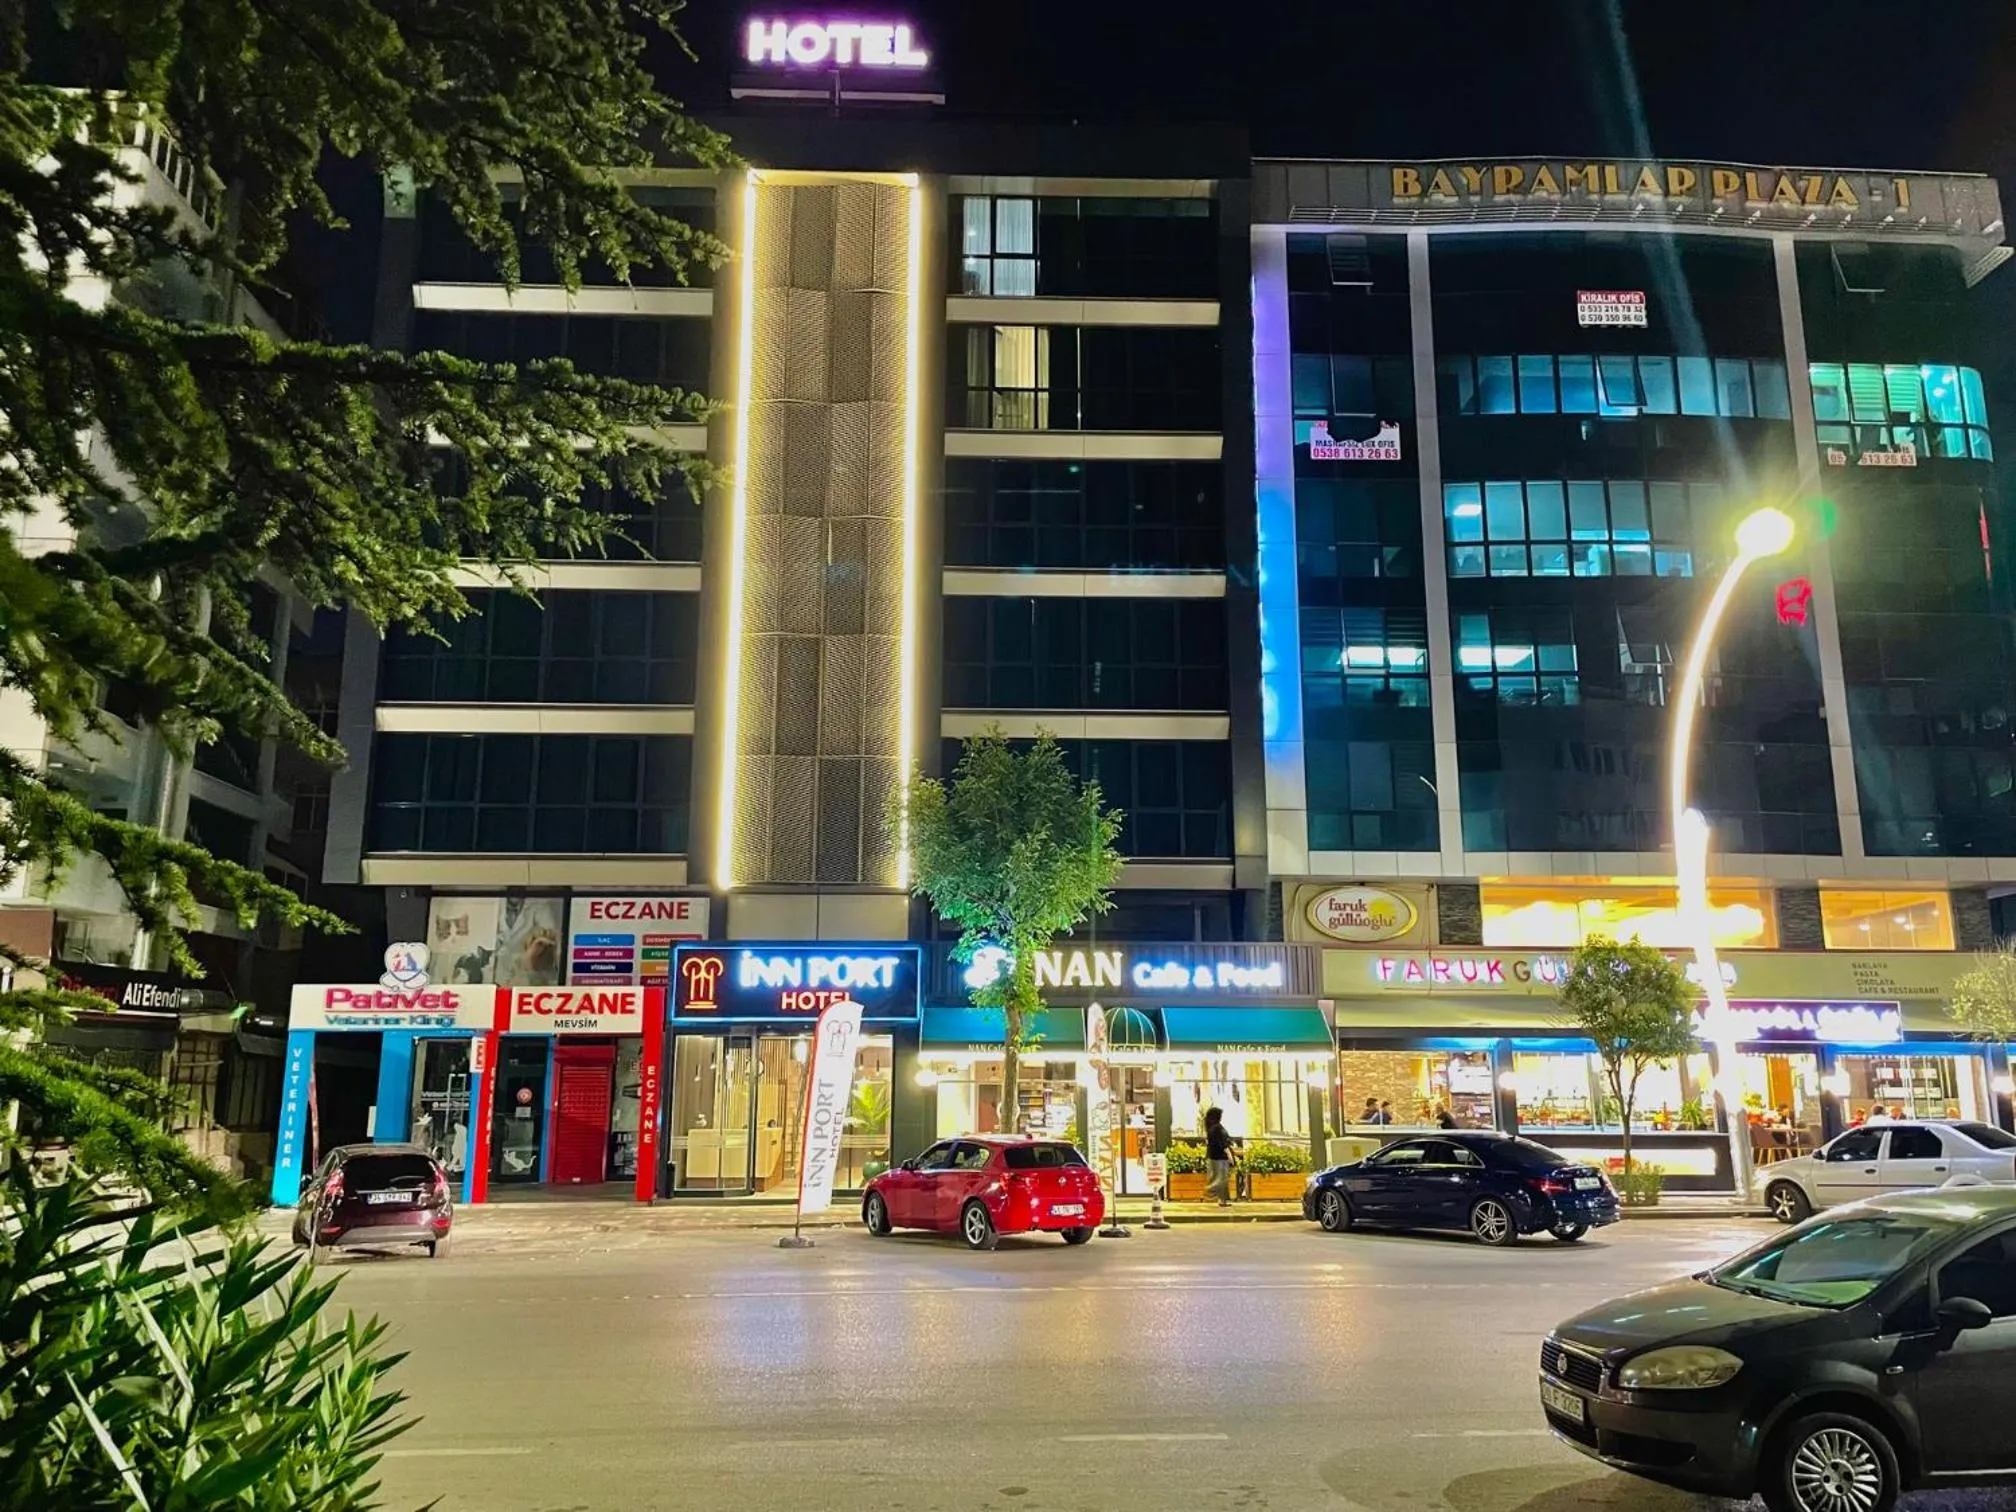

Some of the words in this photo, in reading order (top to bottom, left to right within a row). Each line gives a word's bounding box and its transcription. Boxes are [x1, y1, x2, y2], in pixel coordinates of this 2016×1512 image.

[748, 20, 928, 66] HOTEL
[1392, 164, 1696, 198] BAYRAMLAR
[1712, 168, 1859, 205] PLAZA
[1312, 448, 1341, 457] 0538
[1343, 448, 1364, 458] 613
[1368, 449, 1381, 458] 26
[1385, 449, 1398, 459] 63
[590, 901, 689, 919] ECZANE
[1329, 898, 1367, 912] faruk
[1328, 913, 1393, 930] güllüoğlu
[808, 957, 899, 988] PORT
[1035, 951, 1123, 987] NAN
[1133, 962, 1190, 988] Cafe
[1217, 962, 1282, 987] Food
[1377, 959, 1506, 982] FARUK
[517, 993, 635, 1014] ECZANE
[554, 1018, 597, 1028] MEVSİM
[643, 1065, 656, 1144] ECZANE
[813, 1079, 834, 1140] PORT
